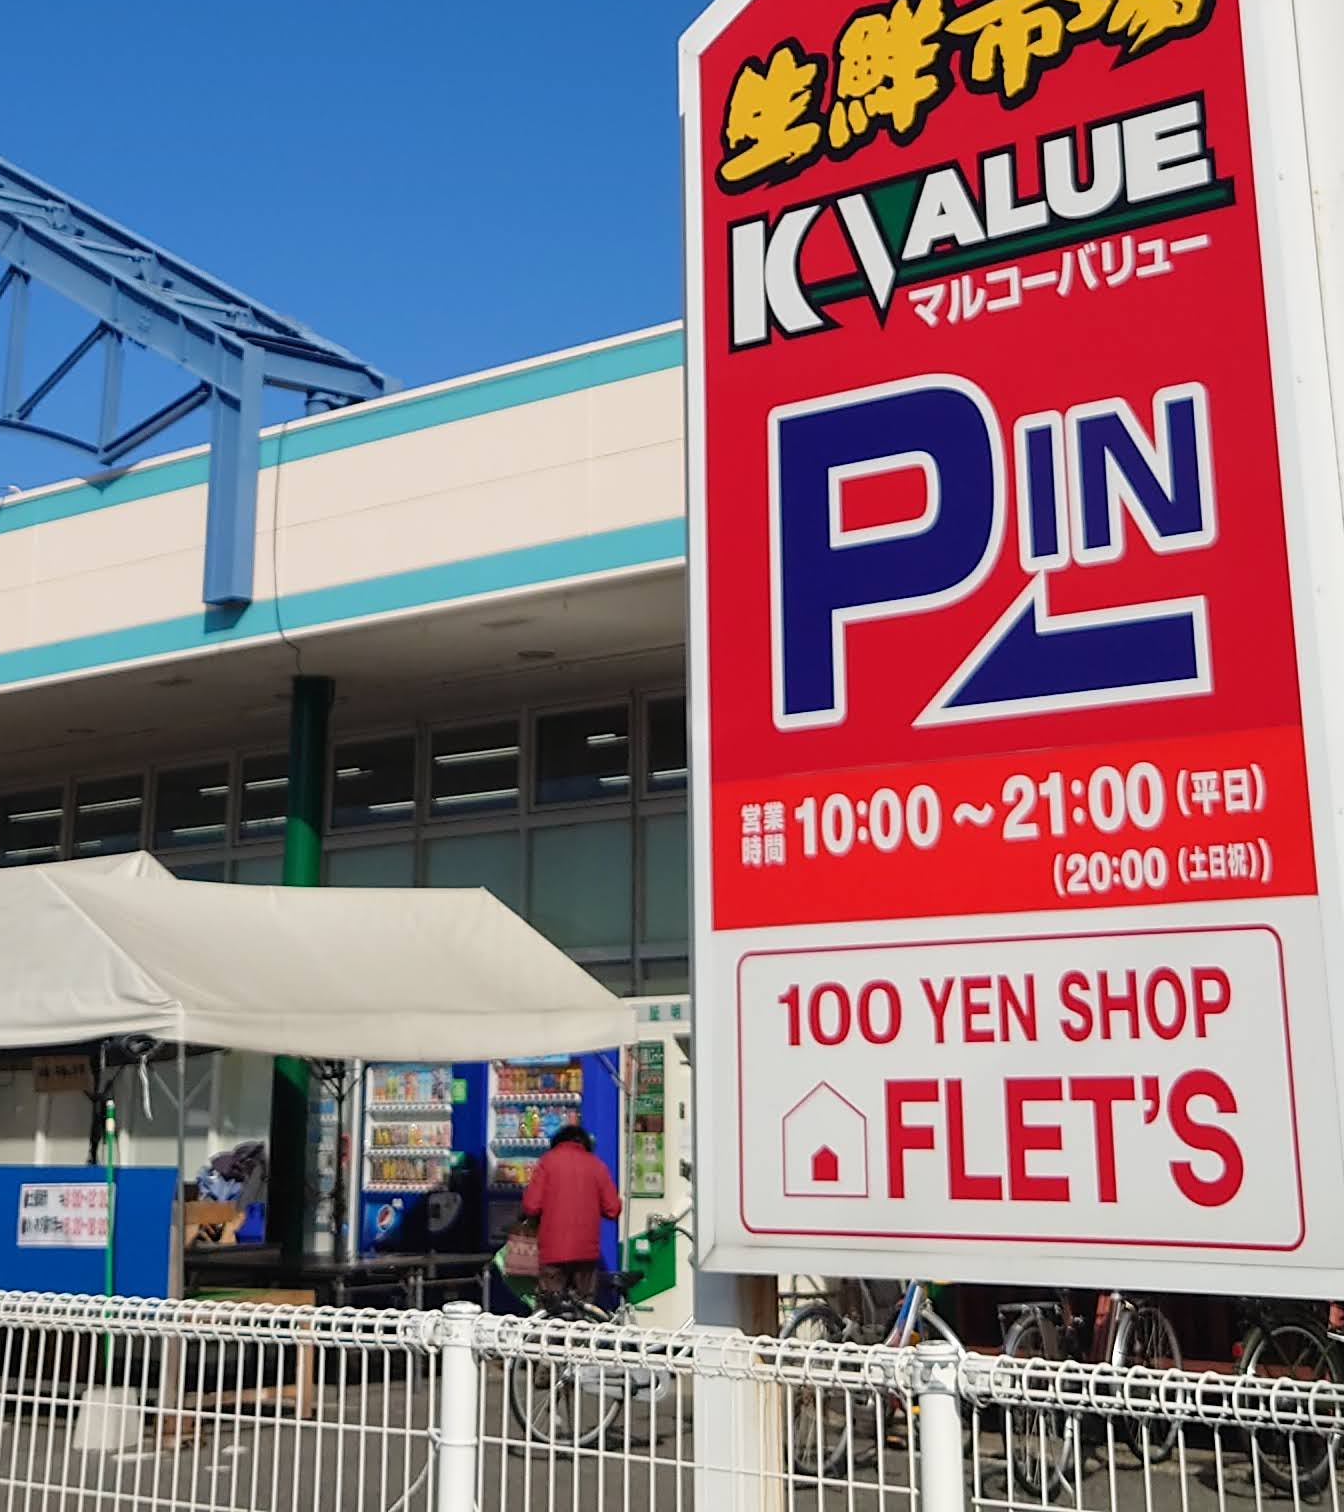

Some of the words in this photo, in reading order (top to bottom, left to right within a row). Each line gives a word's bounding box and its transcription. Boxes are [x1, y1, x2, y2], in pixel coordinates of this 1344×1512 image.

[909, 234, 1212, 326] マルコーバリュー
[777, 980, 902, 1047] 100
[919, 973, 1038, 1044] YEN
[1059, 965, 1232, 1042] SHOP
[883, 1067, 1245, 1208] FLET'S
